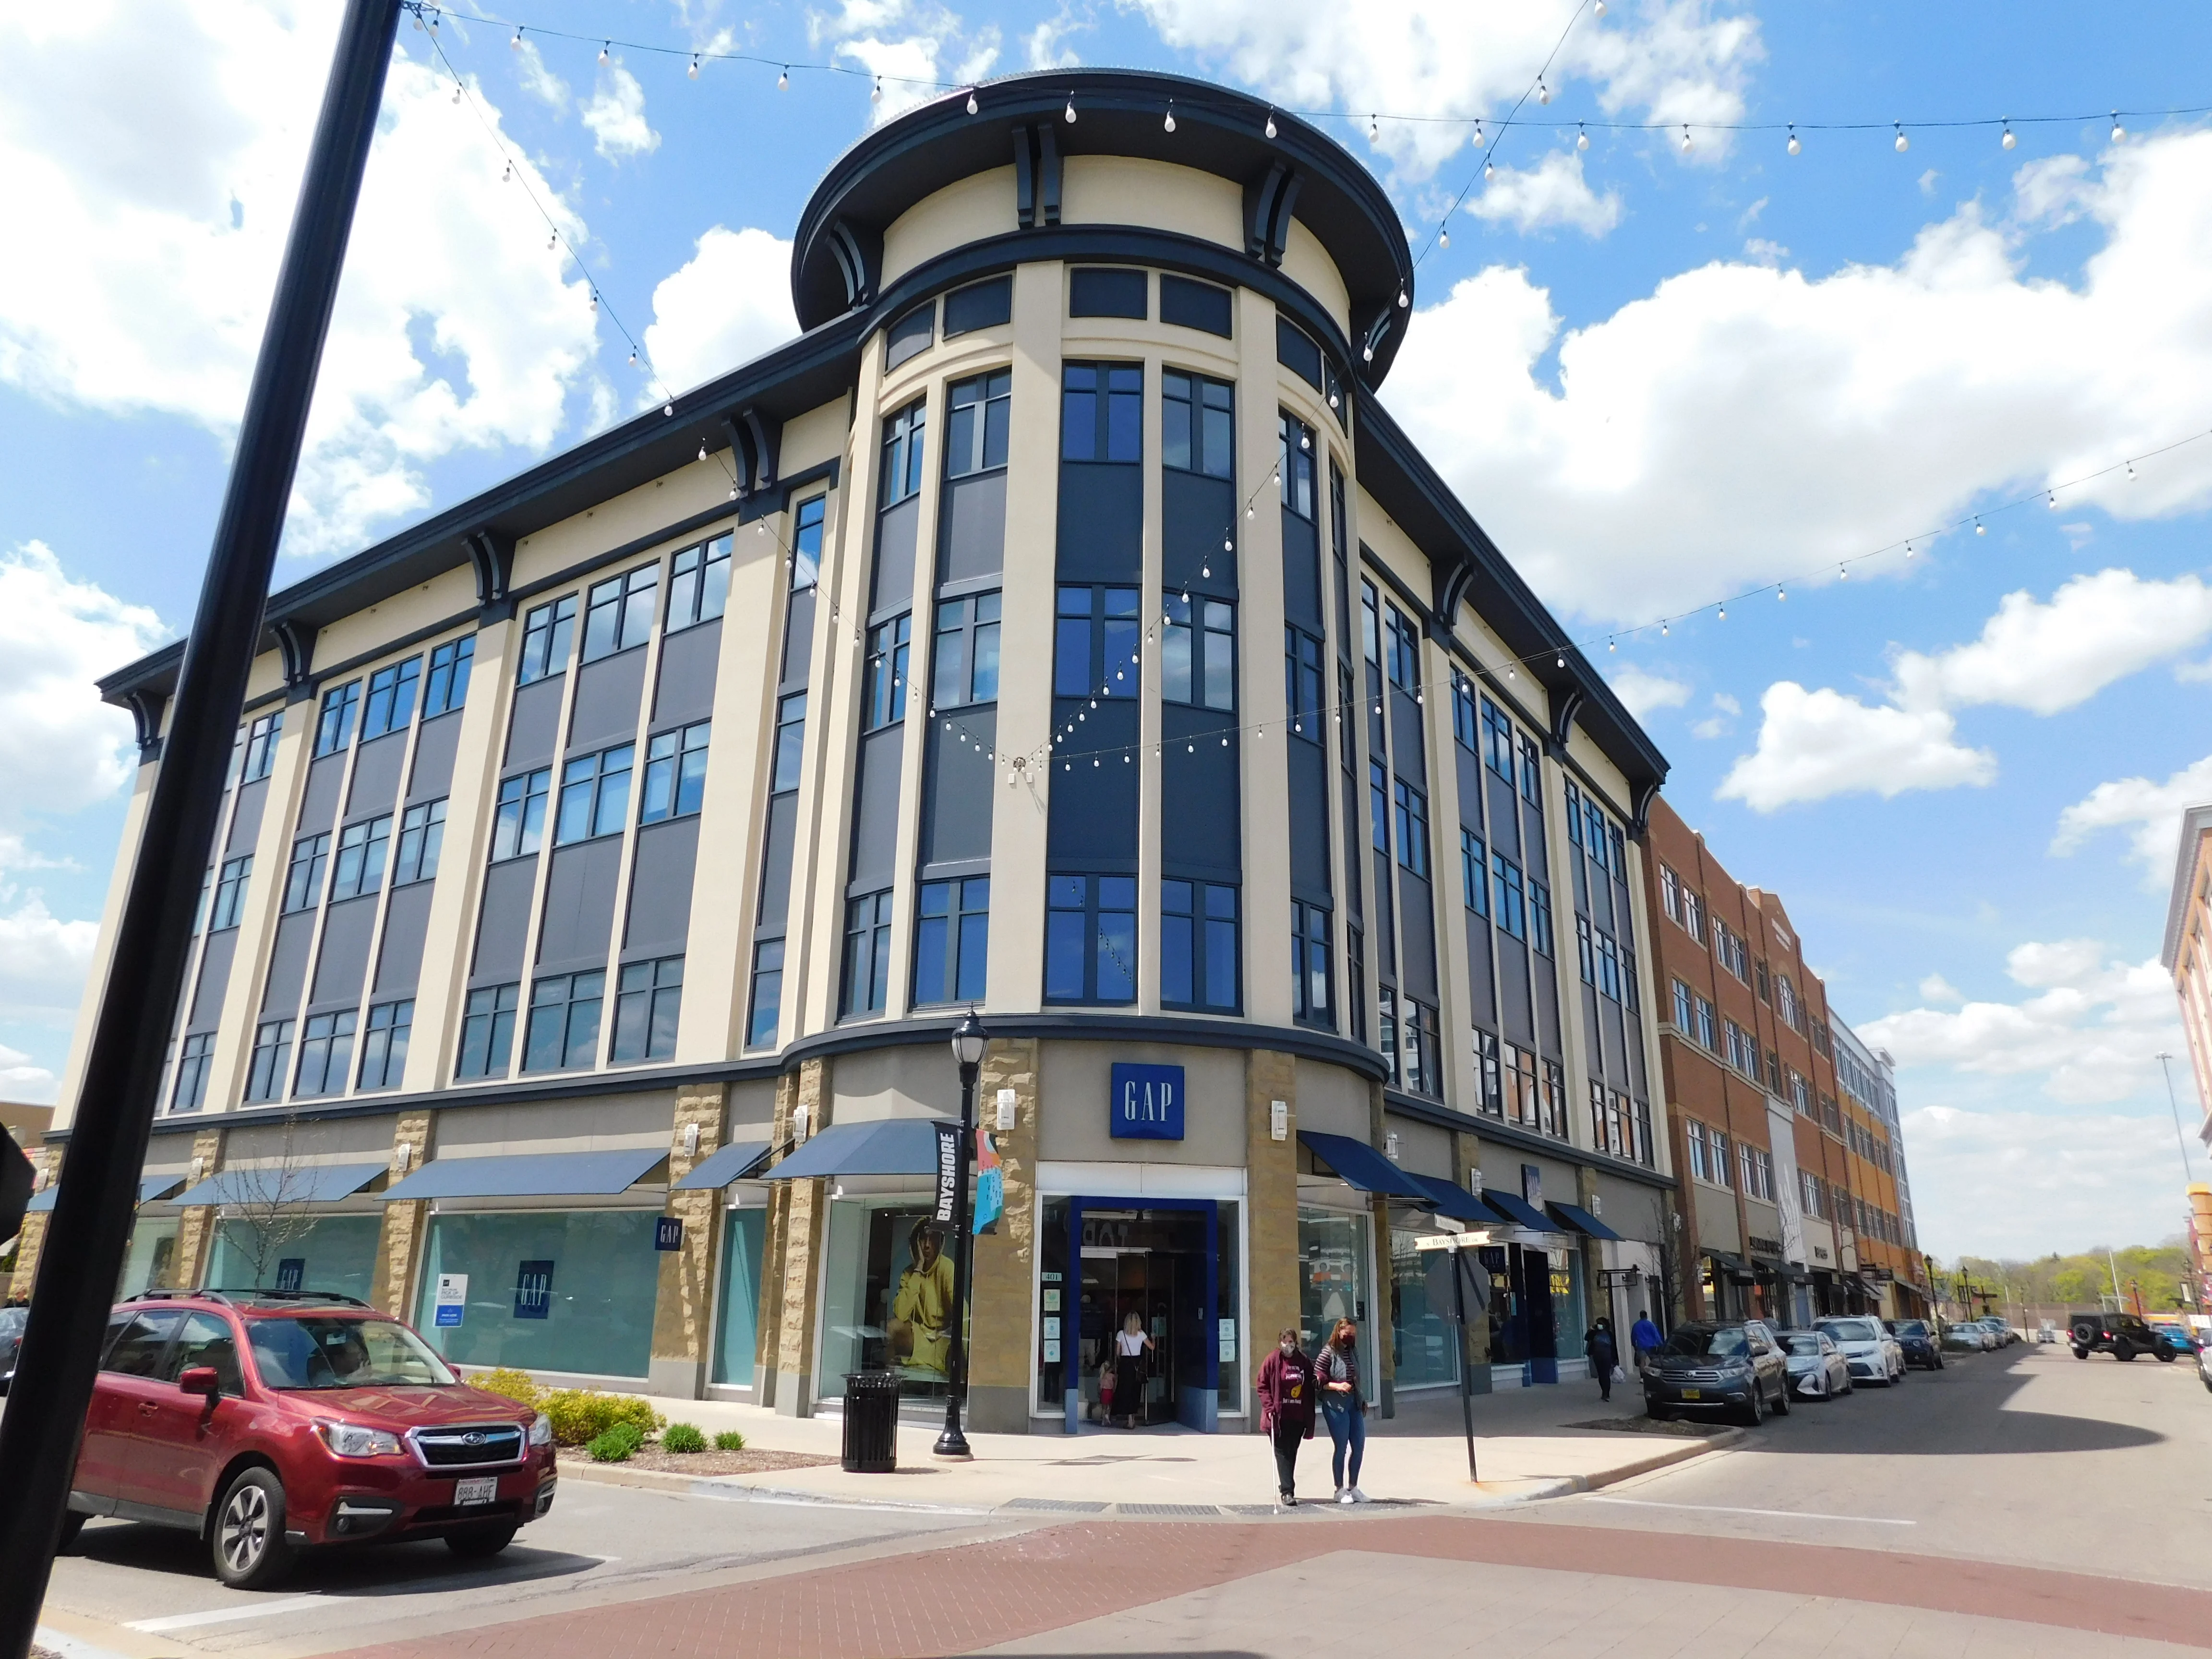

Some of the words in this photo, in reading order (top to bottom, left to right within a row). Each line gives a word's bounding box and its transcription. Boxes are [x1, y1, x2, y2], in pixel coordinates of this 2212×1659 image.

[1125, 1081, 1172, 1121] GAP
[936, 1132, 955, 1221] BAYSHORE
[660, 1225, 679, 1243] GAP
[1484, 1251, 1500, 1264] GAP
[521, 1274, 547, 1306] GAP
